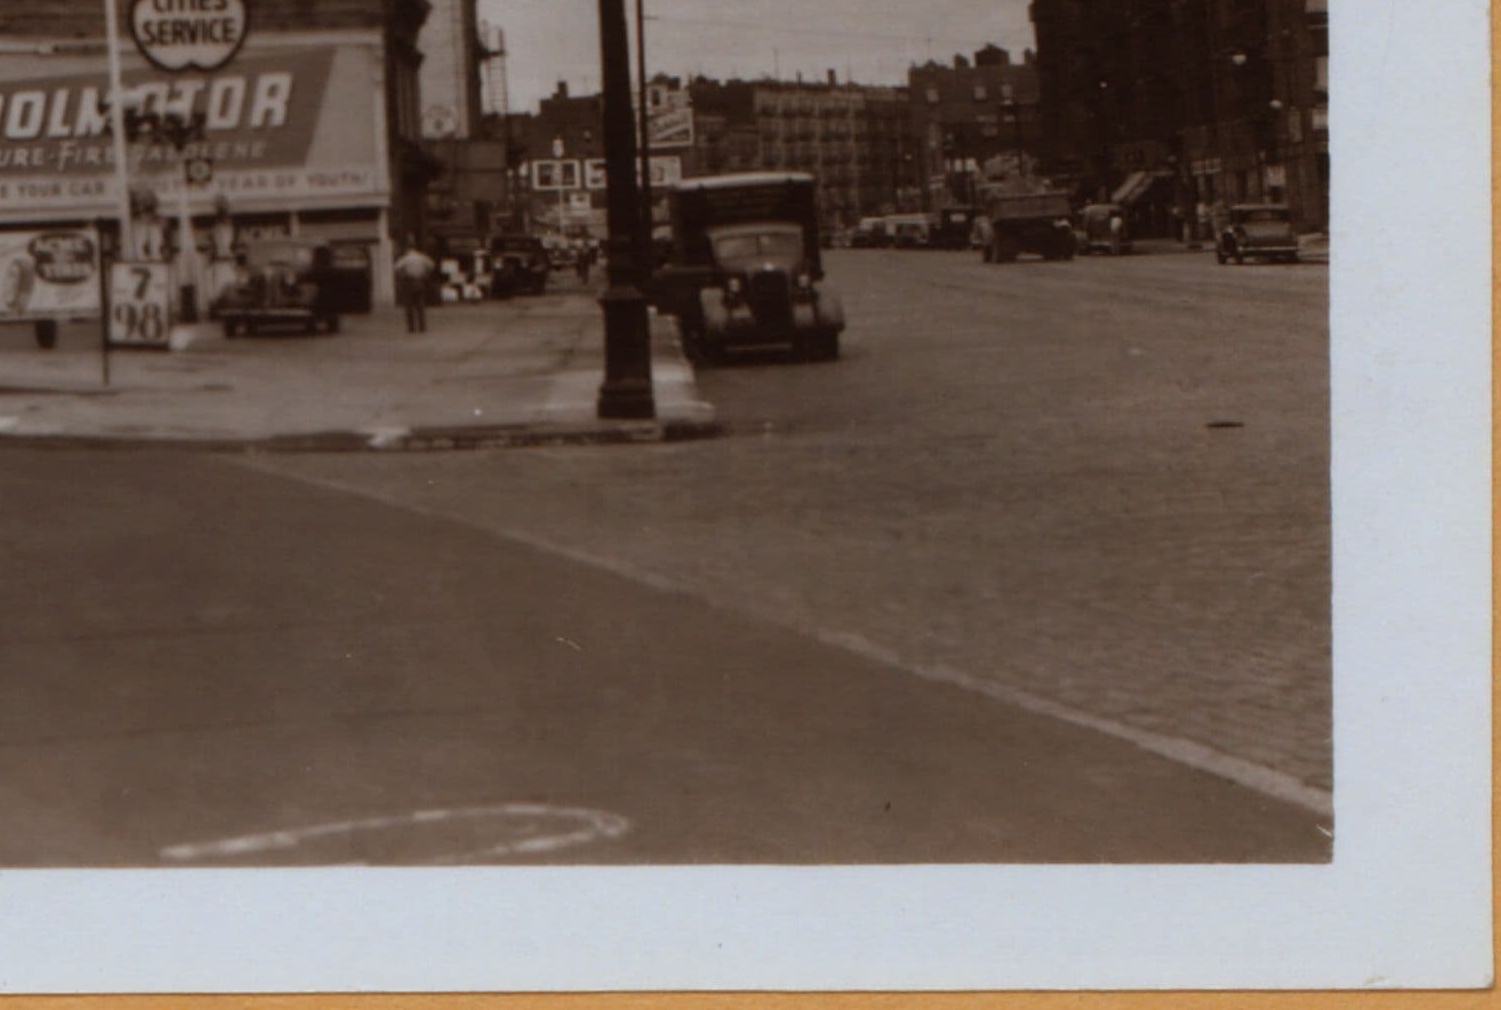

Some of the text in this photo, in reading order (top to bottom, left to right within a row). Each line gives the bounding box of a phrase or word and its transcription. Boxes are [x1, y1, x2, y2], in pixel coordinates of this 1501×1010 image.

[141, 17, 238, 46] SERVICE
[18, 181, 61, 198] YOUR
[68, 180, 106, 195] CAR
[129, 266, 151, 300] 7
[113, 301, 162, 339] 98
